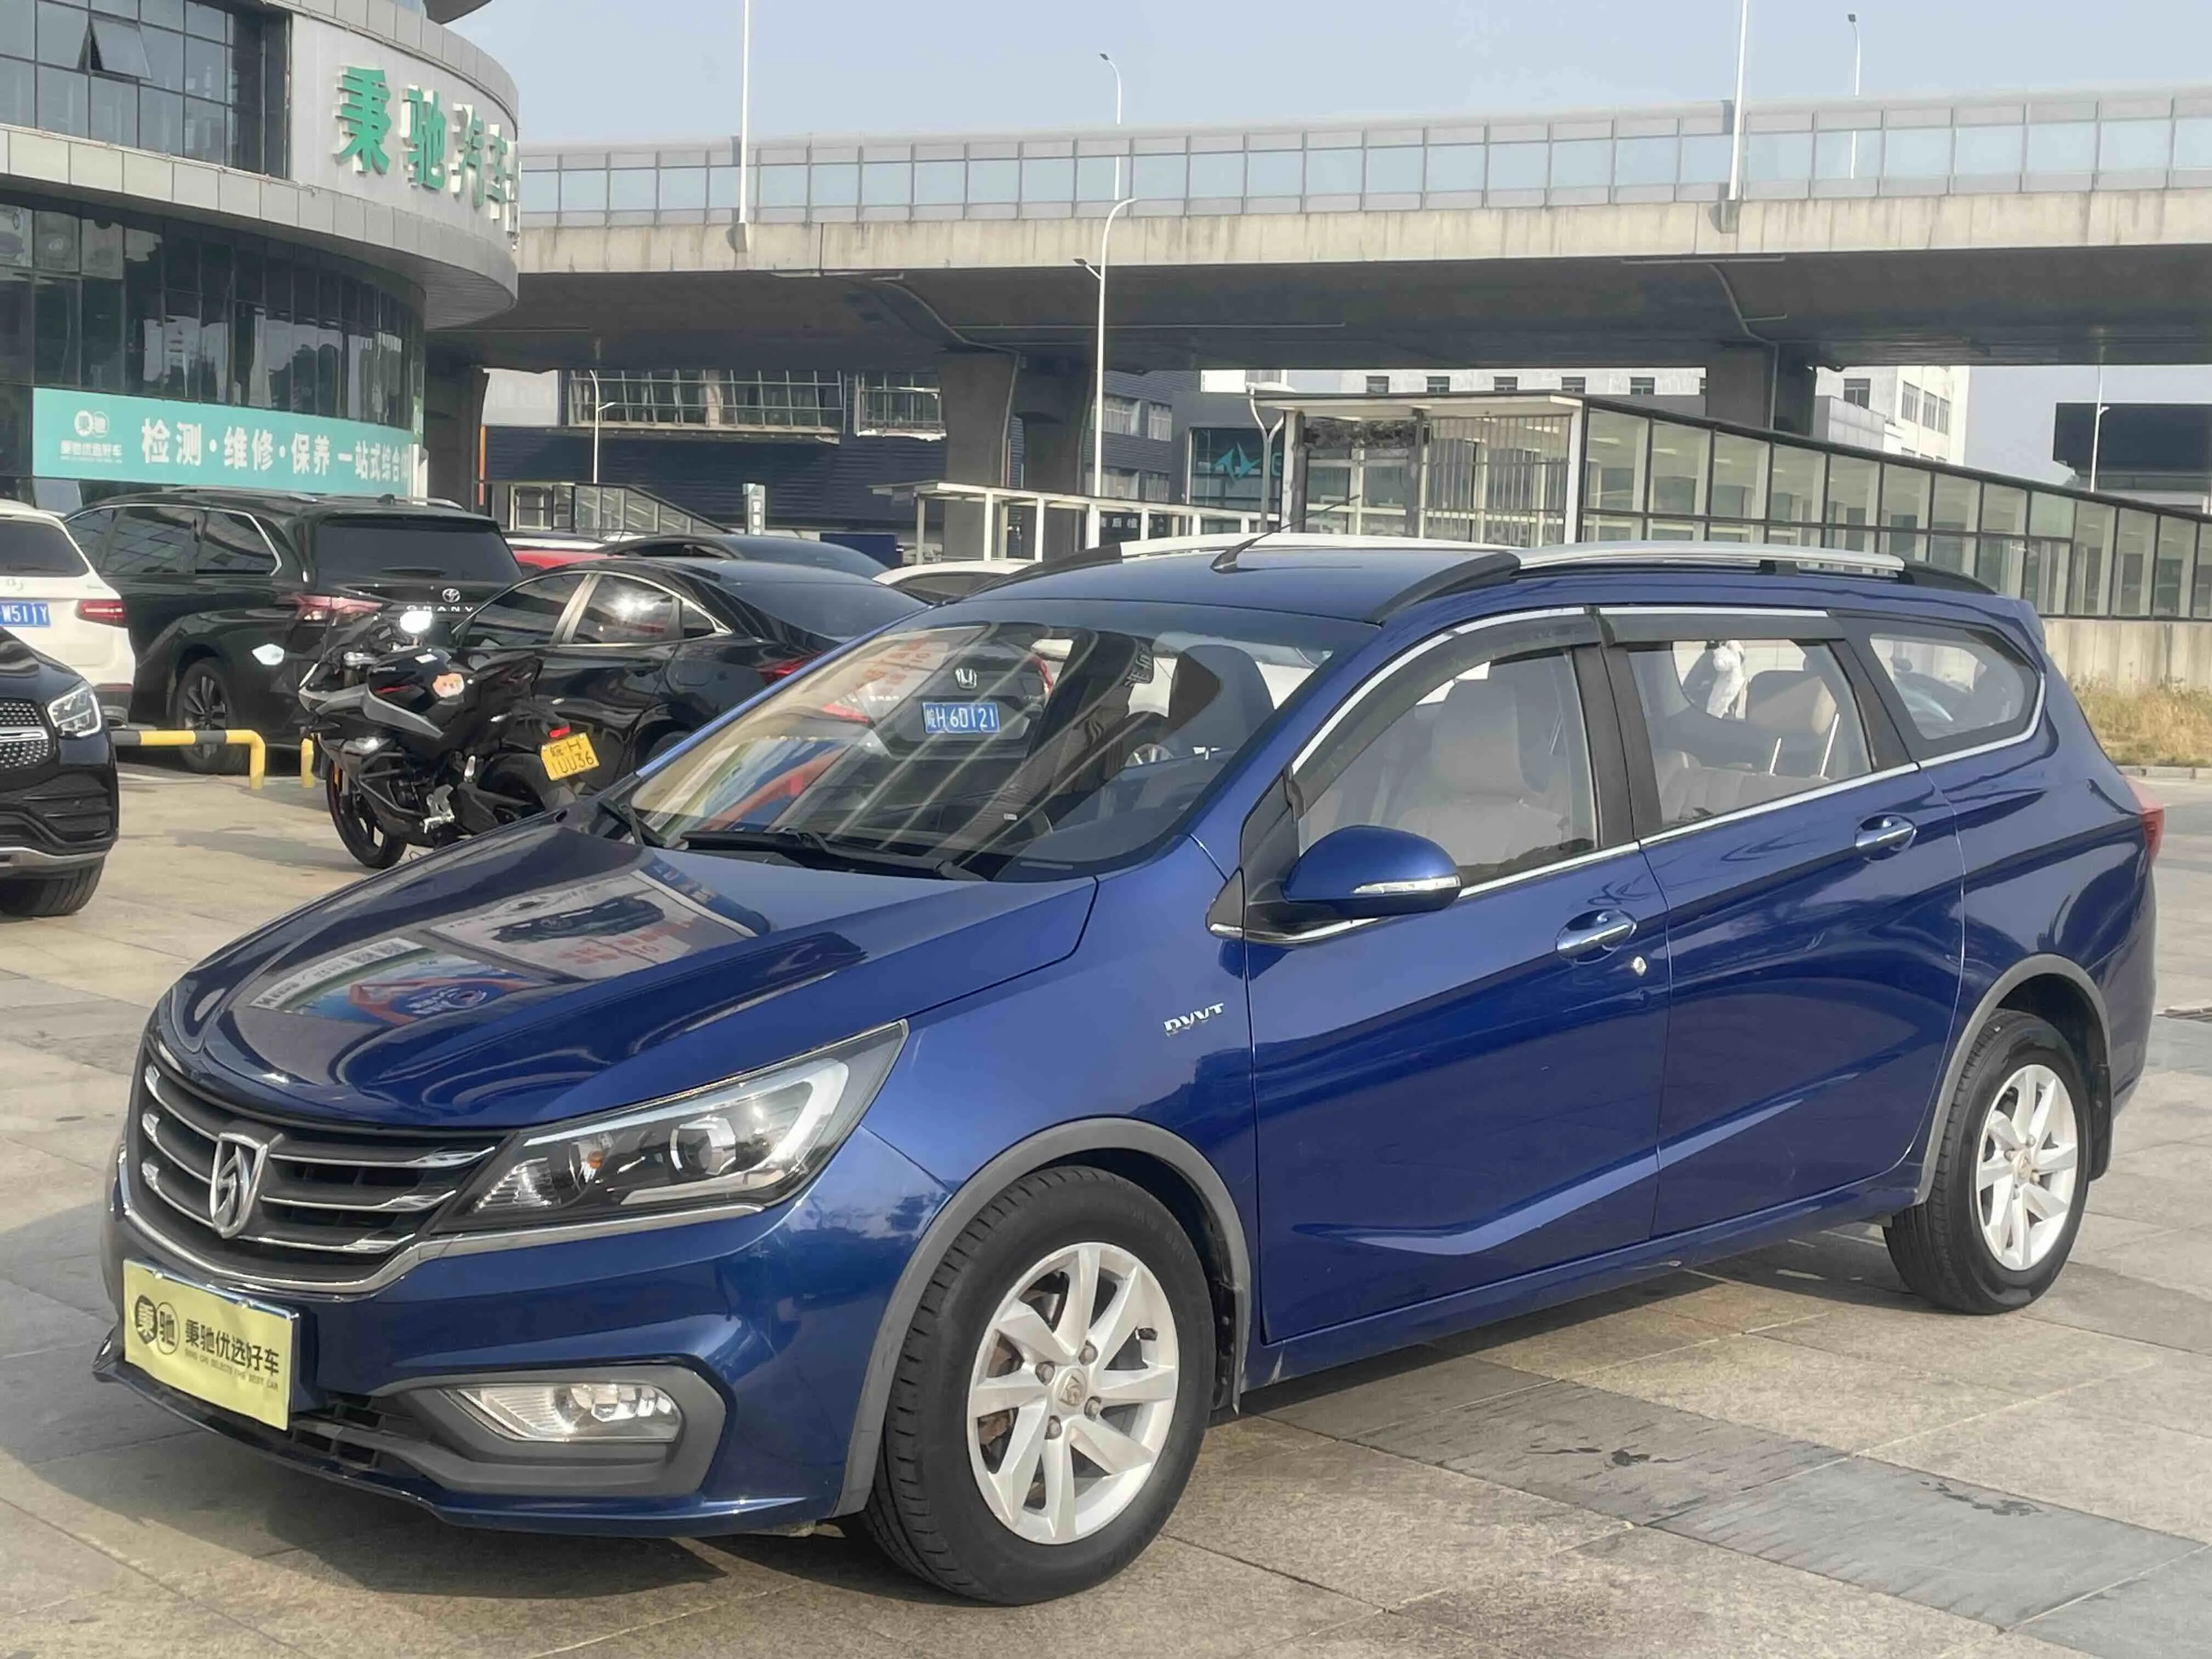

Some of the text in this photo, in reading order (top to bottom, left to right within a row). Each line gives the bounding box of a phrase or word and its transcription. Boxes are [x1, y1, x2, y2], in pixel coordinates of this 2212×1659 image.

[1164, 1002, 1224, 1031] DVVT
[185, 1318, 279, 1376] 秉驰优选好车
